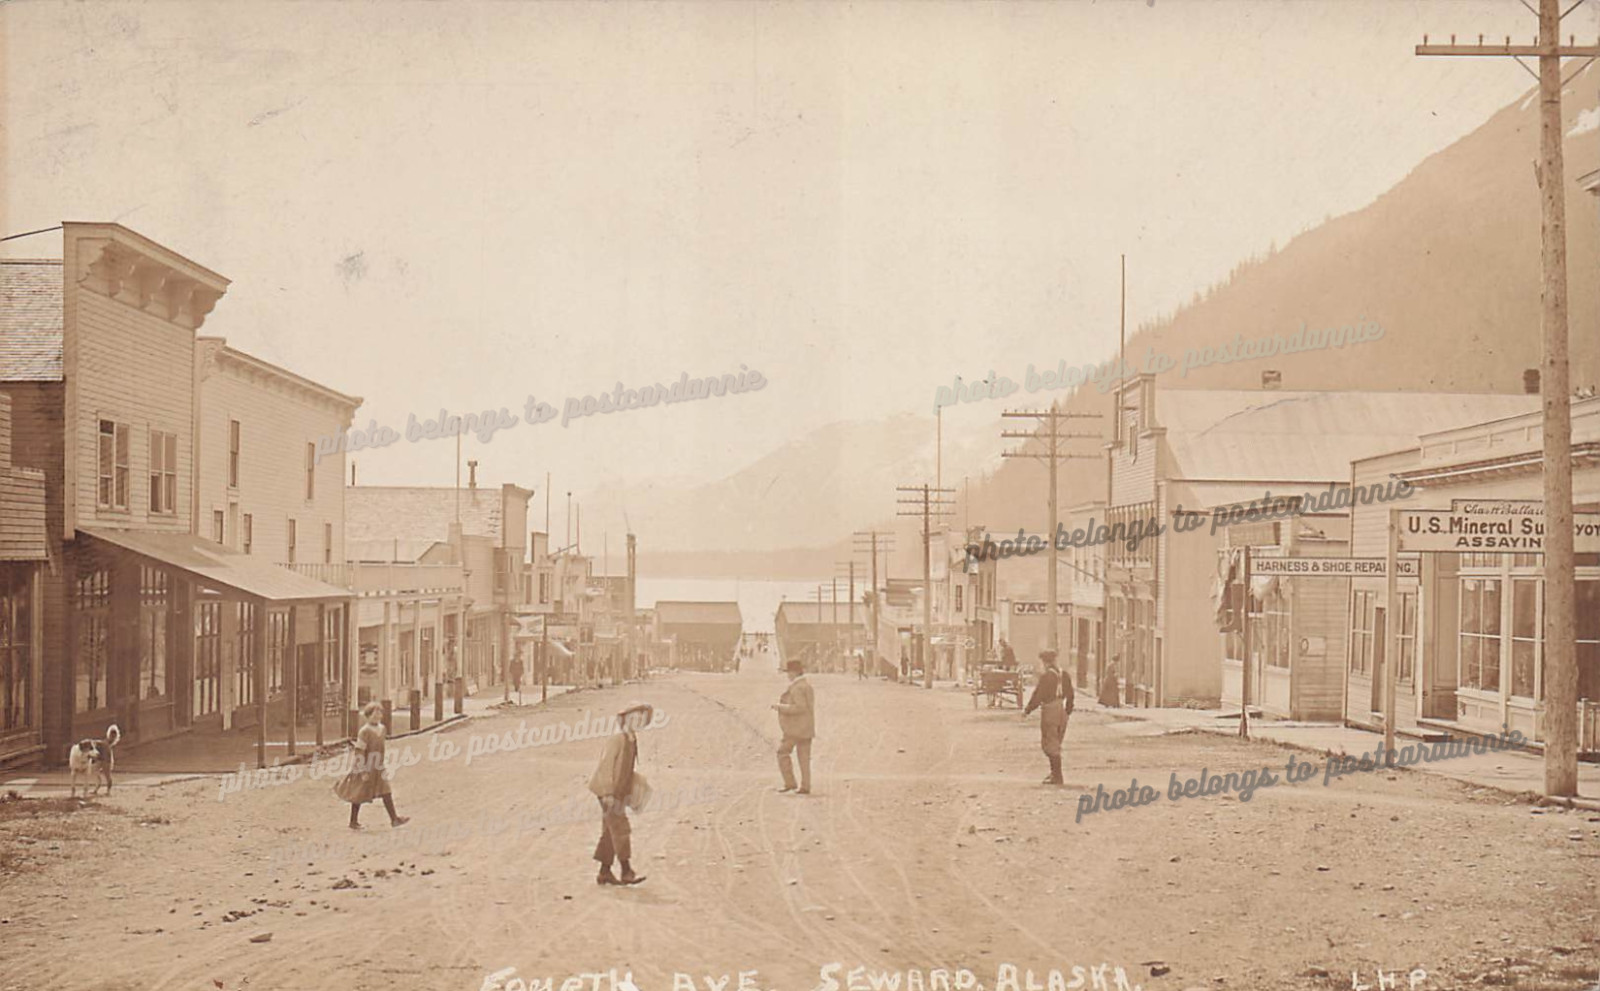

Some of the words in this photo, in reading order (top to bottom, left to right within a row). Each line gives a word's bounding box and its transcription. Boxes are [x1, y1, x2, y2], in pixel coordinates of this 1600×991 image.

[1449, 516, 1512, 535] Mineral
[1456, 536, 1542, 548] ASSAYIN
[1257, 561, 1309, 571] HARNESS
[1311, 561, 1320, 571] &
[1322, 562, 1352, 572] SHOE
